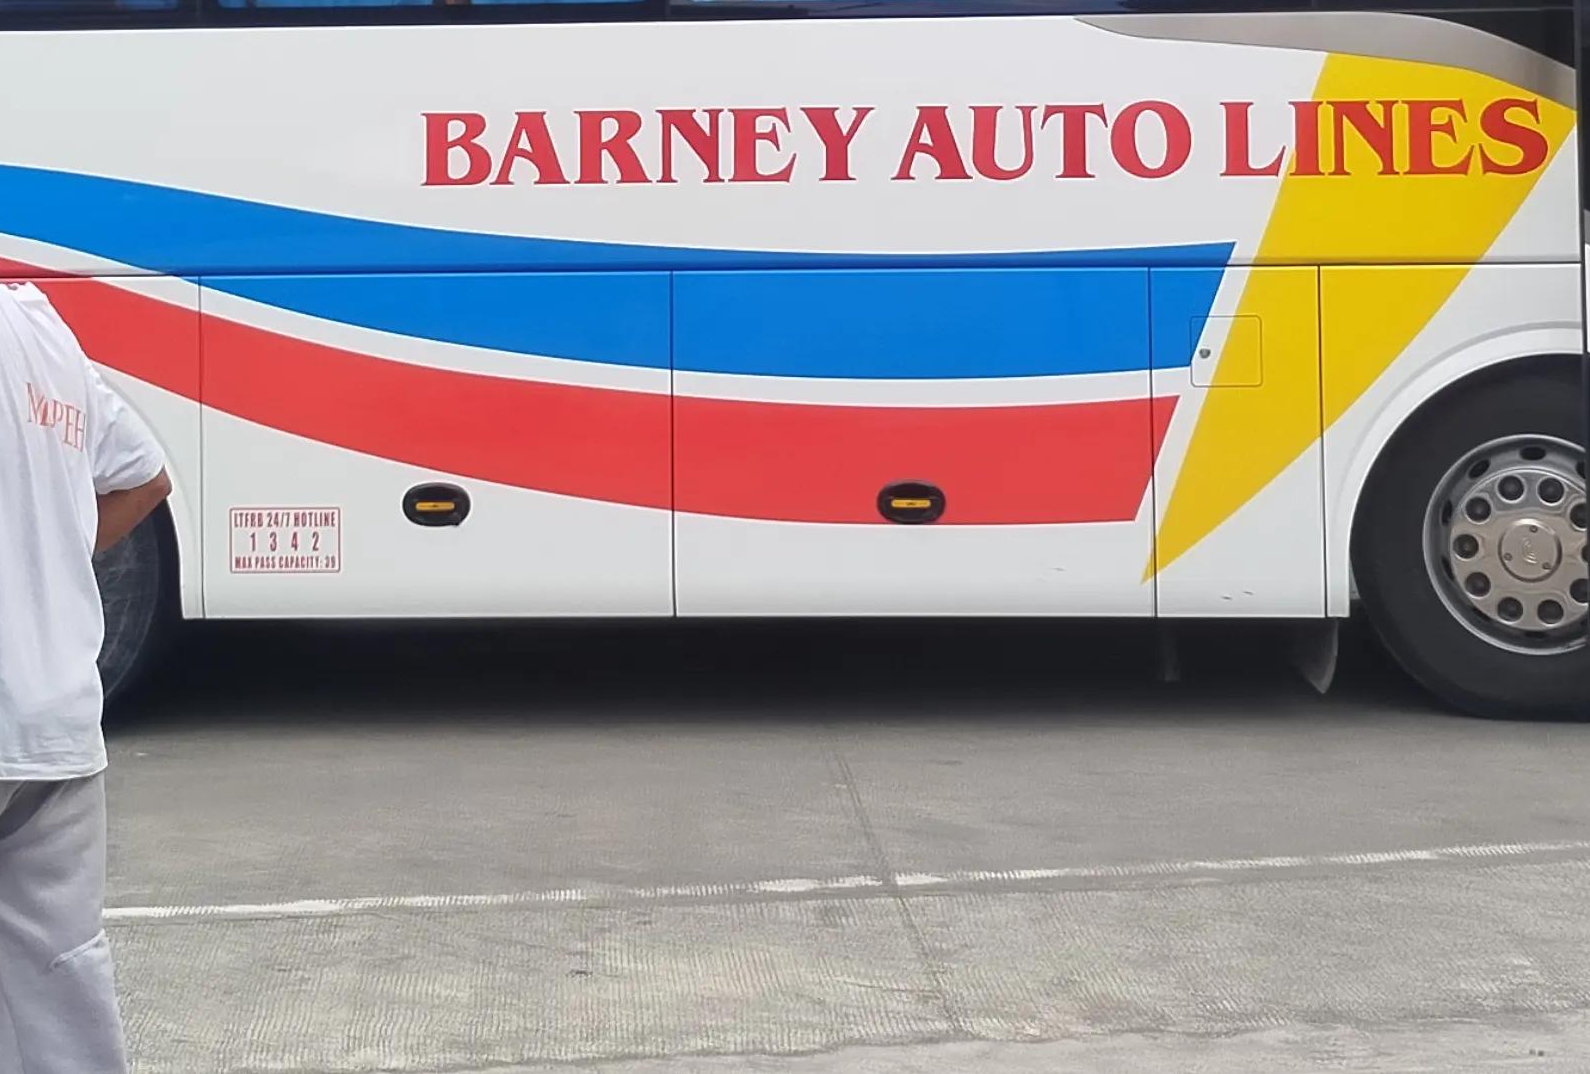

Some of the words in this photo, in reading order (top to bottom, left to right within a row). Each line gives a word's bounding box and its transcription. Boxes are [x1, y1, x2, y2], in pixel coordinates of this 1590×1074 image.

[421, 106, 876, 186] BARNEY
[891, 100, 1192, 181] AUTO
[1219, 97, 1549, 177] LINES
[233, 512, 263, 528] LTFRB
[266, 512, 291, 527] 24/7
[293, 511, 336, 527] HOTLINE
[234, 556, 253, 569] MAX
[255, 556, 276, 569] PASS
[278, 556, 323, 569] CAPACITY:
